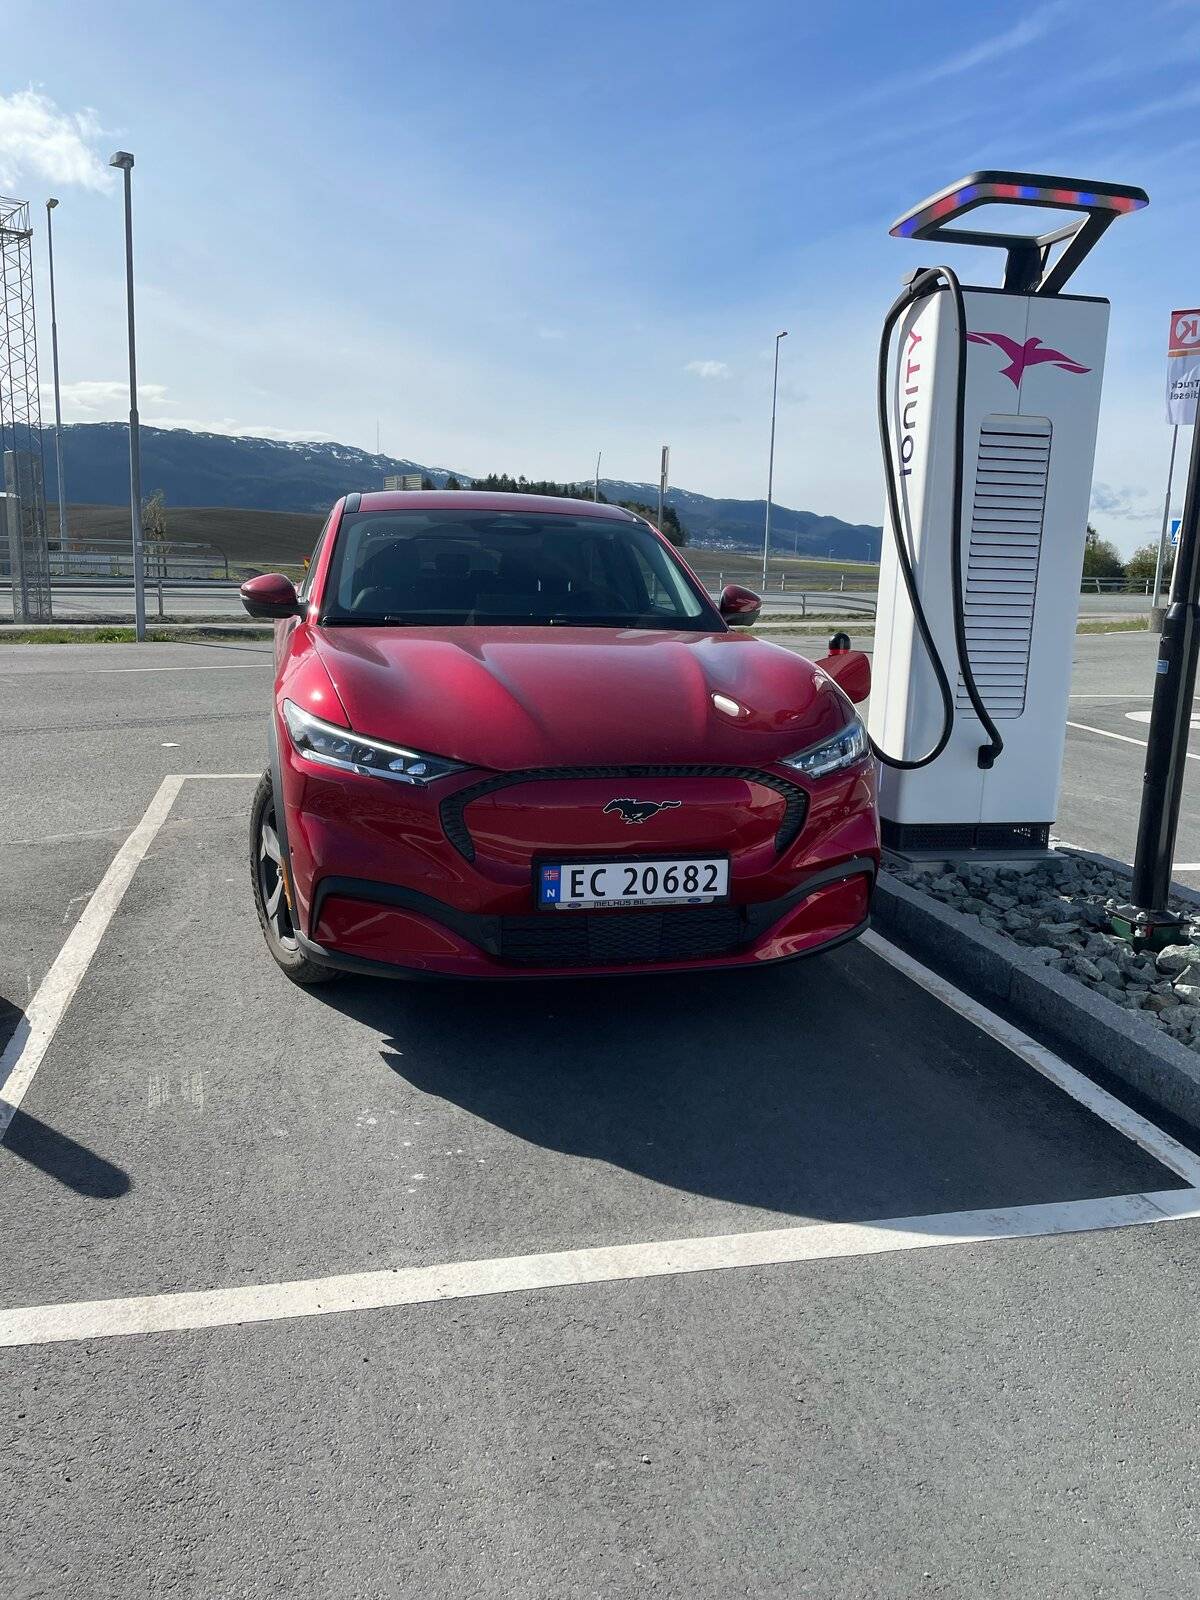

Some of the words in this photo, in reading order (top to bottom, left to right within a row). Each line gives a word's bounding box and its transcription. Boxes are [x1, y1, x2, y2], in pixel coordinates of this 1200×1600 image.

[899, 330, 922, 477] IONITY
[546, 888, 556, 898] N
[570, 869, 607, 898] EC
[622, 864, 718, 896] 20682
